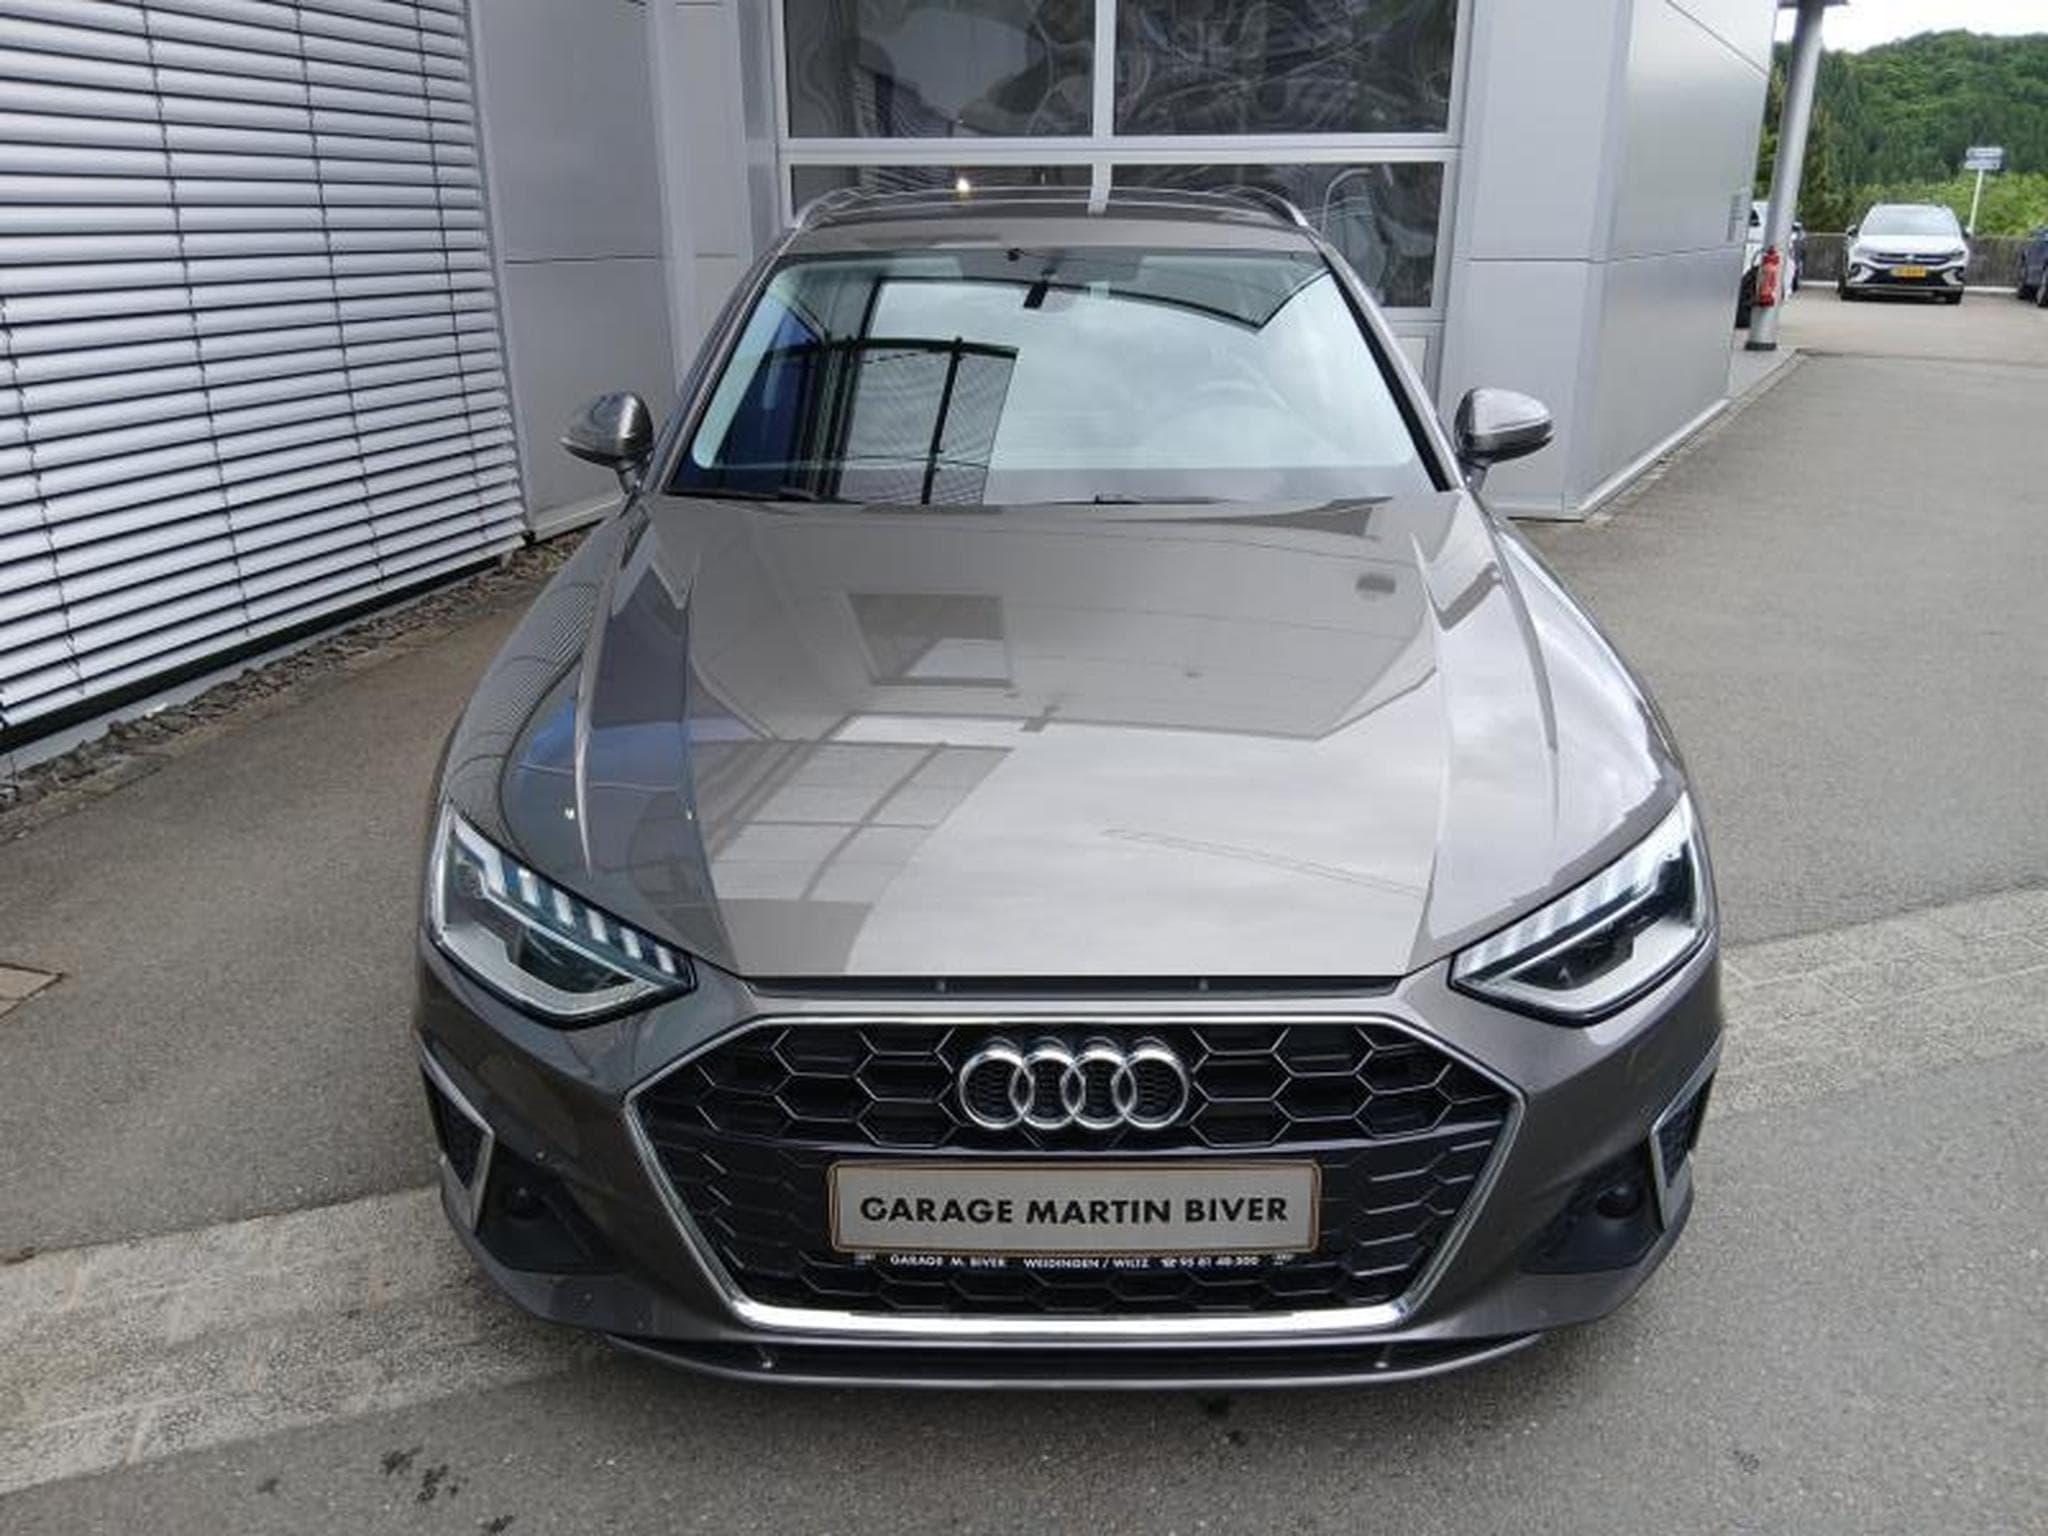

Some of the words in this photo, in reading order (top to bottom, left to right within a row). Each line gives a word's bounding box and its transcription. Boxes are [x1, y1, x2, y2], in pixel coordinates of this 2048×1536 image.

[860, 1197, 1013, 1224] GARAGE
[1026, 1199, 1171, 1224] MARTIN
[1184, 1198, 1288, 1223] BIVER
[890, 1254, 943, 1266] GARAGE
